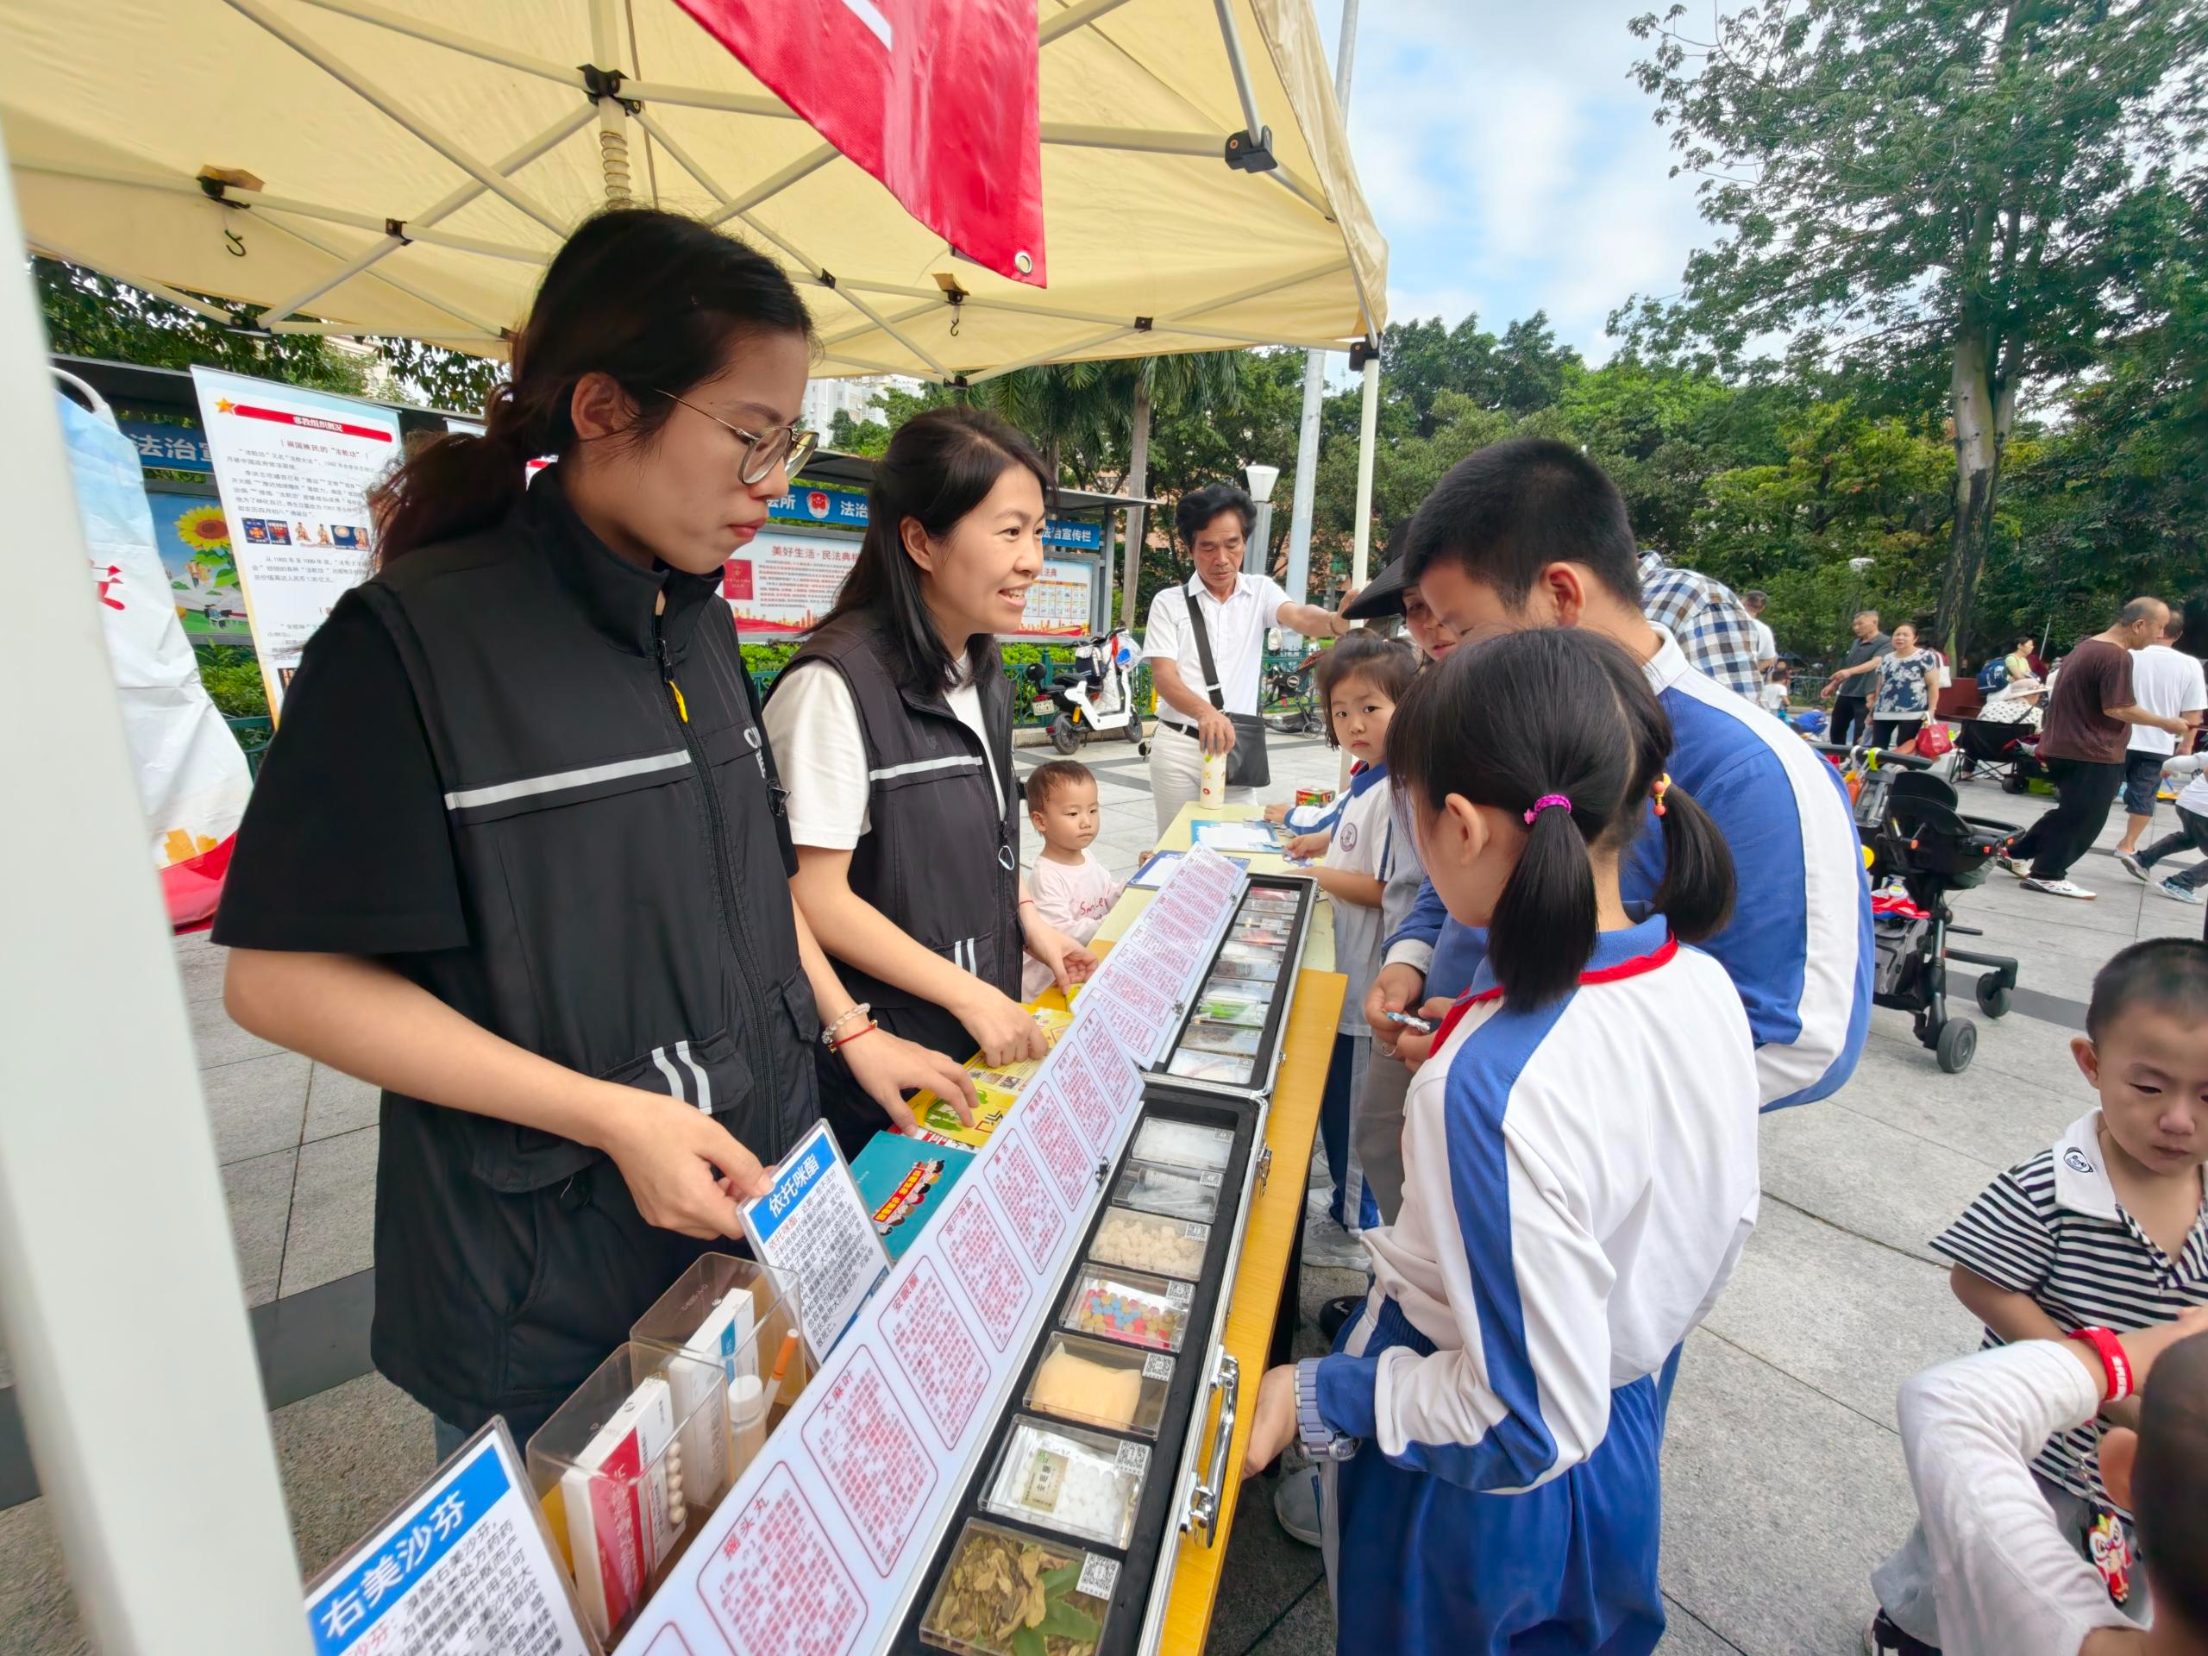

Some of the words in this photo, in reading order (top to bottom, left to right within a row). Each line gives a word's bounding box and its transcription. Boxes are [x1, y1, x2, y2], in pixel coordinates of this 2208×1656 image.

[840, 500, 868, 518] 法治
[766, 1150, 821, 1220] 依托咪酯
[818, 1366, 856, 1420] 大麻叶
[720, 1489, 771, 1563] 摇头丸
[320, 1489, 467, 1640] 右美沙芬
